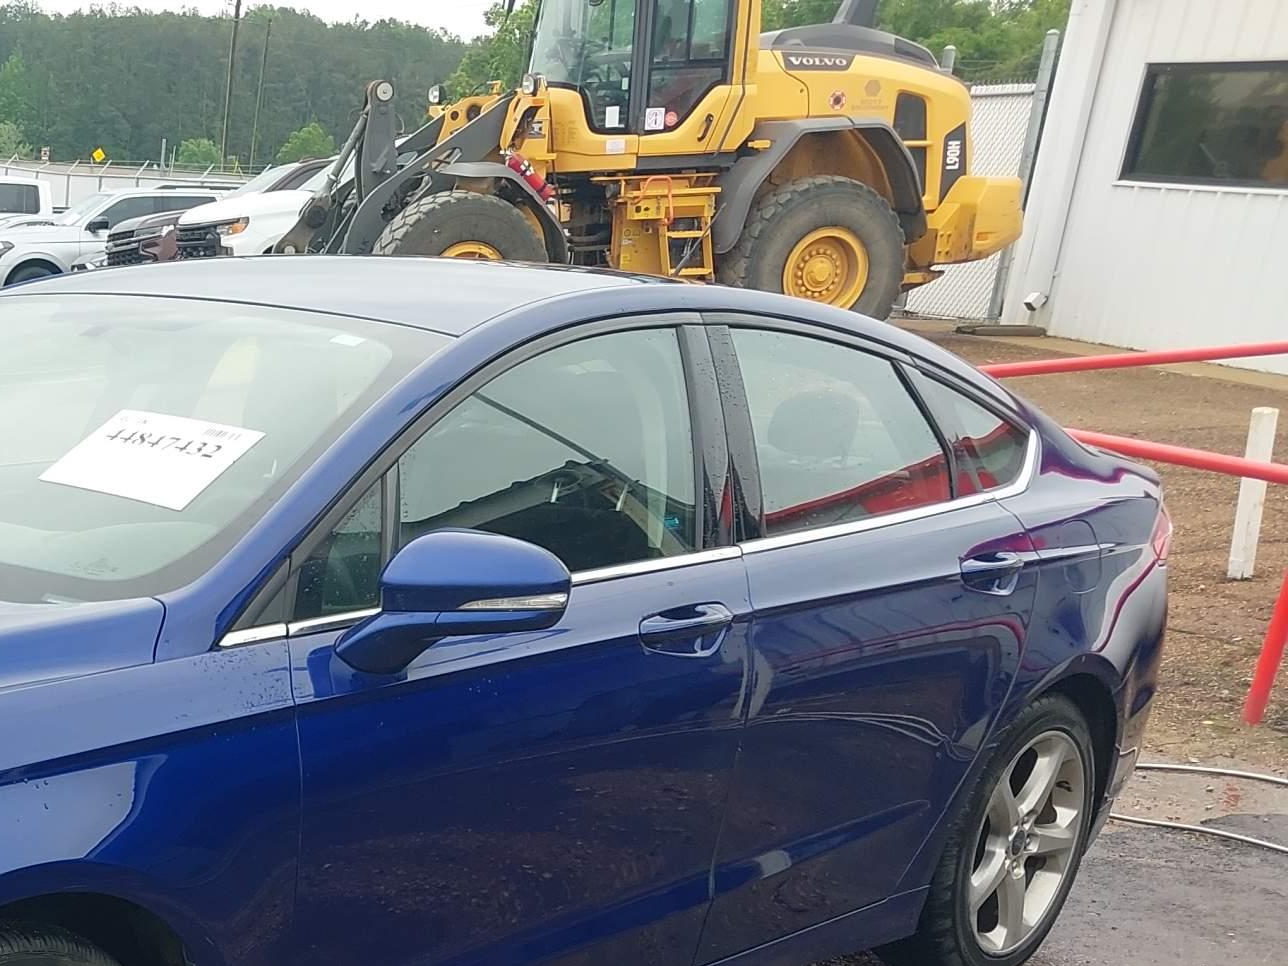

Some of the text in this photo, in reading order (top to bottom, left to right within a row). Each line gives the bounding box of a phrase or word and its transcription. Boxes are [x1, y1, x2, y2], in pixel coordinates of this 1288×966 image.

[788, 56, 847, 66] VOLVO
[945, 140, 962, 170] L90H
[105, 428, 222, 459] 44847432
